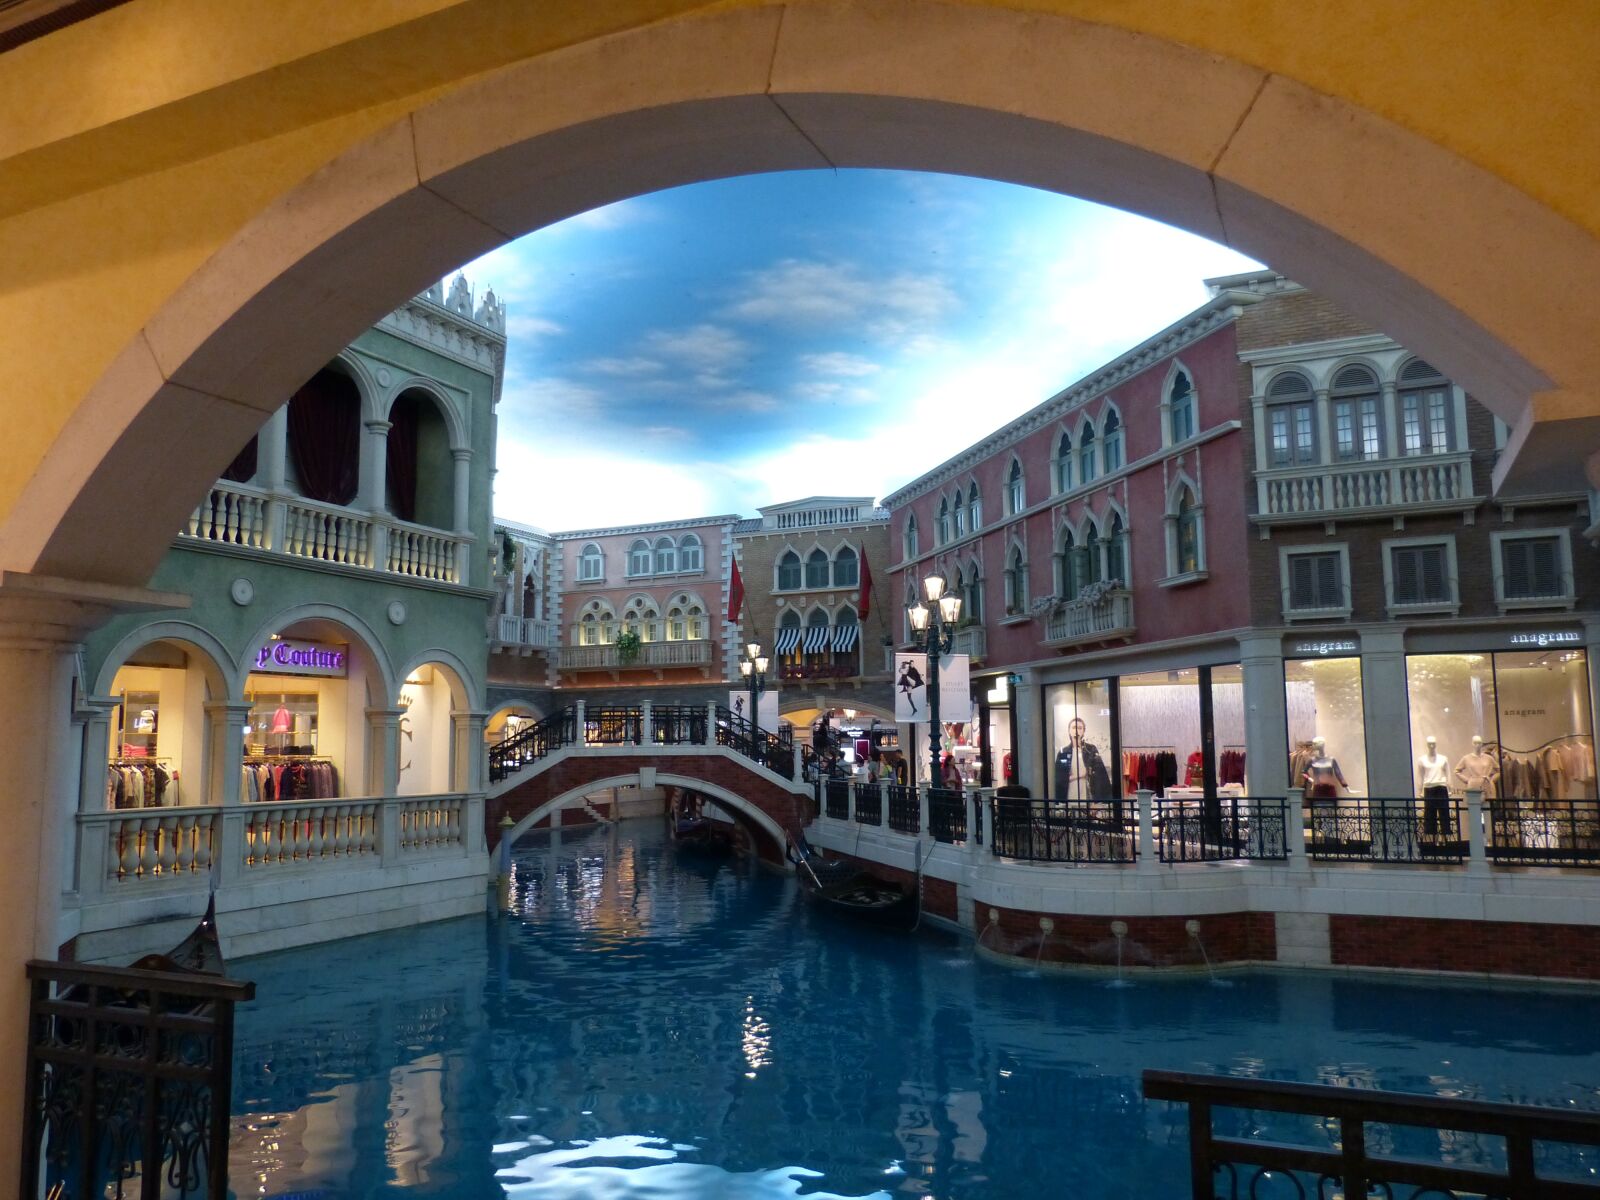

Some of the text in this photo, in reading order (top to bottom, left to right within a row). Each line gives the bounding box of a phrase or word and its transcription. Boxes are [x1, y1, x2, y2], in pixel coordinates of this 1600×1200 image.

[1511, 632, 1580, 645] anagram
[1296, 641, 1356, 653] anagram
[272, 643, 344, 668] Couture
[1504, 709, 1546, 717] anagram
